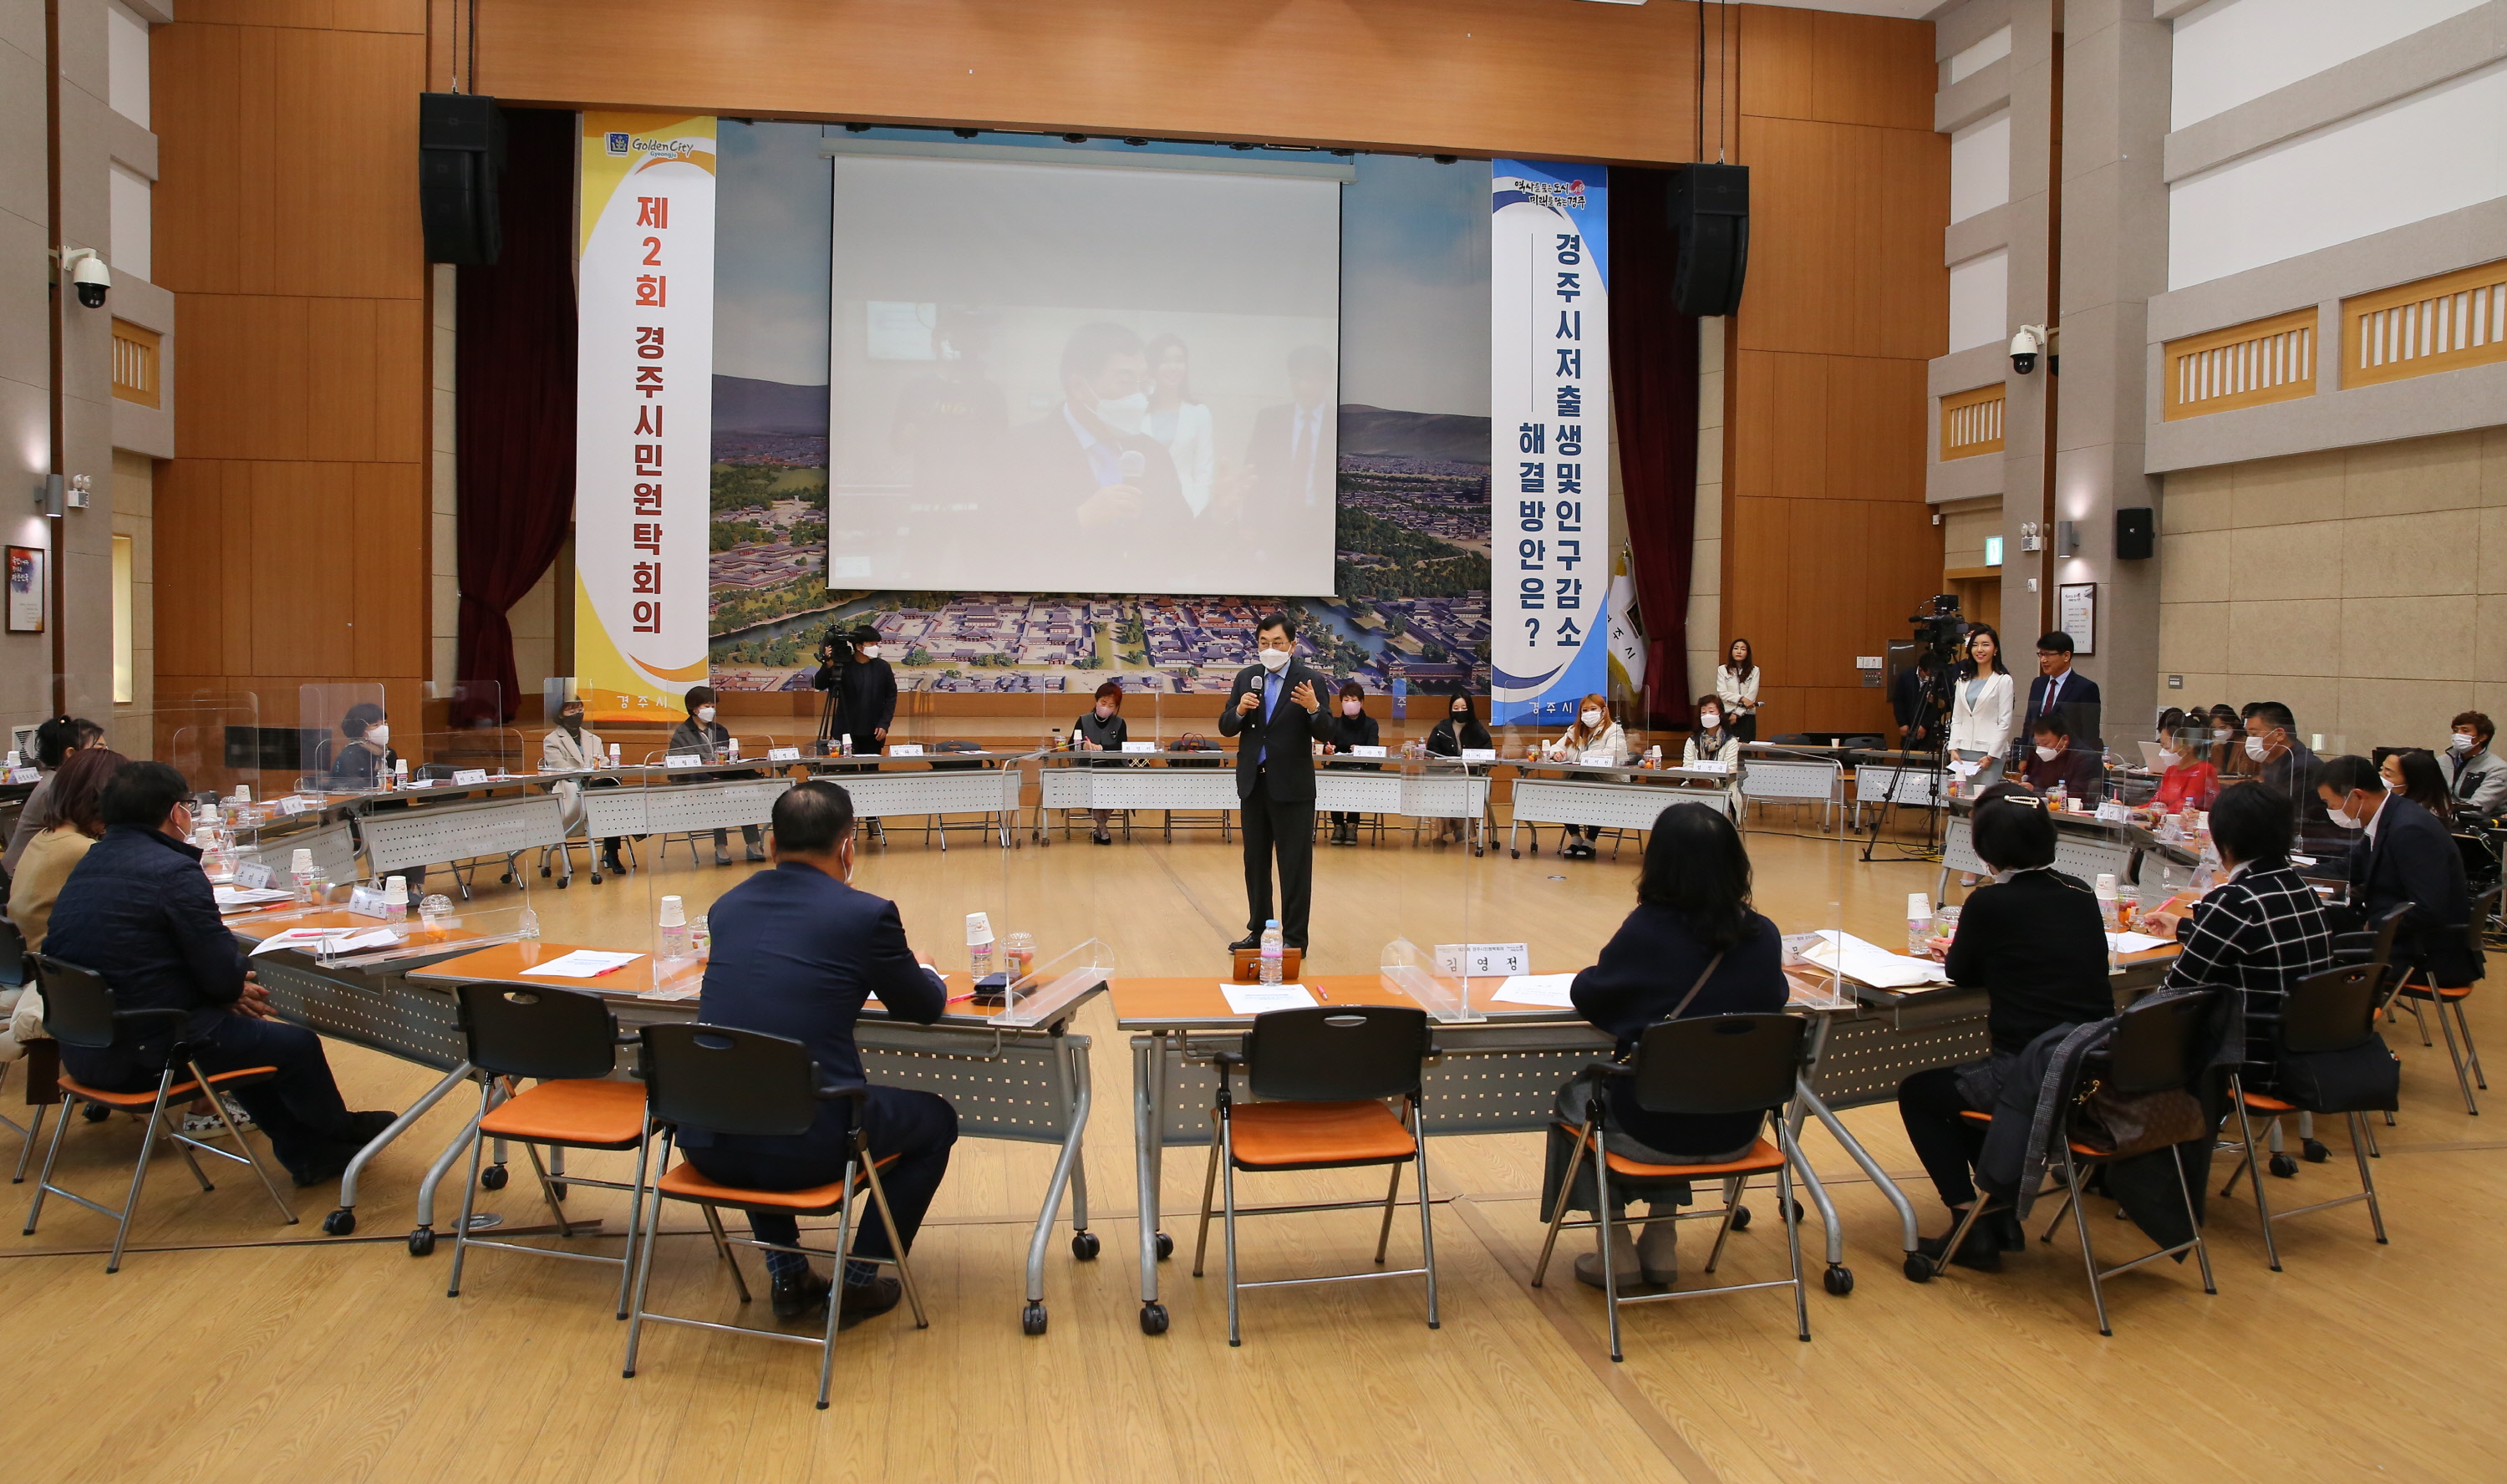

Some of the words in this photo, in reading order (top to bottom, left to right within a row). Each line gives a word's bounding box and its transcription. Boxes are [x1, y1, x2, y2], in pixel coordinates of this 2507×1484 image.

[632, 138, 669, 151] Golden
[669, 140, 694, 157] City
[1514, 180, 1540, 193] 역사를
[1554, 183, 1569, 195] 도시
[1529, 194, 1554, 206] 미래를
[1568, 196, 1586, 209] 경주
[635, 196, 669, 307] 제2회
[632, 326, 664, 633] 경주시민원탁회의
[1518, 423, 1546, 647] 해결방안은?
[616, 695, 668, 709] 경주시
[1528, 701, 1573, 714] 경주시
